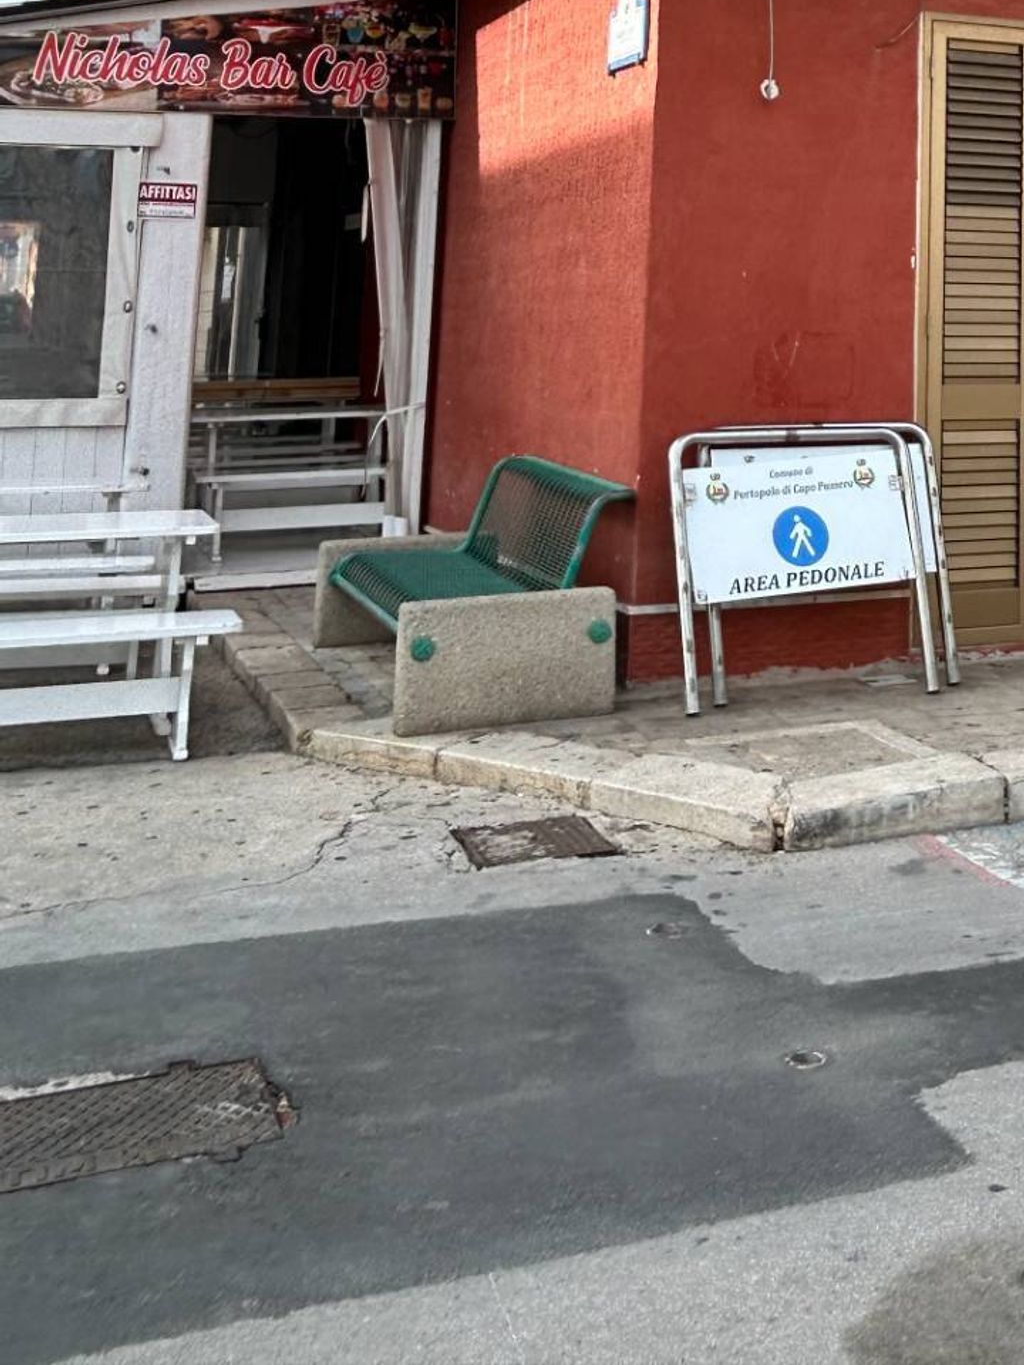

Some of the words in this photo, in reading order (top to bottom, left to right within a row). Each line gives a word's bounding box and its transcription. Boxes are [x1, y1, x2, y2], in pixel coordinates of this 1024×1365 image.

[33, 31, 210, 87] Nicholas
[220, 38, 297, 90] Bar
[140, 185, 196, 200] AFFITTASI
[729, 573, 780, 595] AREA
[786, 561, 885, 588] PEDONALE
